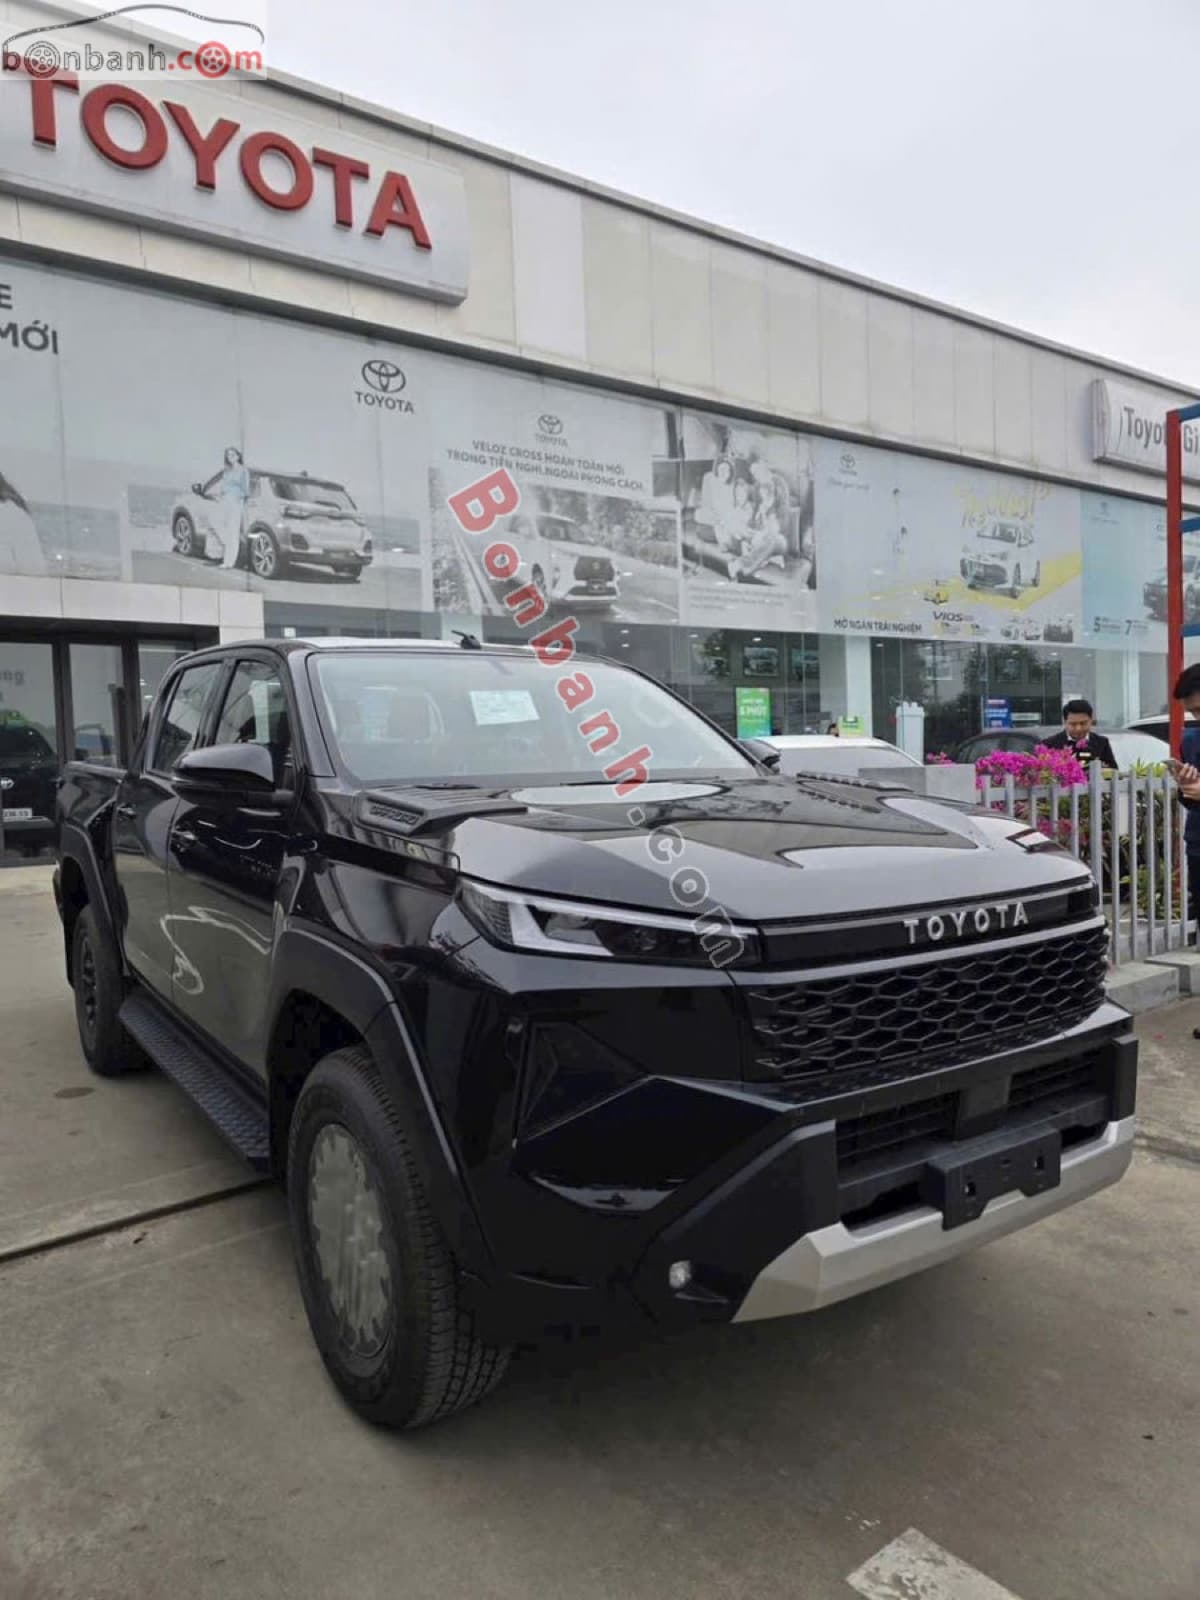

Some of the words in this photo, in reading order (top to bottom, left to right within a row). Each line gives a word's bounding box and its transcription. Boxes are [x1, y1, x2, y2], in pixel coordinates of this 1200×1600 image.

[6, 58, 432, 250] TOYOTA
[355, 391, 415, 415] TOYOTA
[1123, 405, 1167, 449] Toyo
[447, 449, 487, 465] TRONG
[472, 440, 507, 455] VELOZ
[509, 446, 542, 461] CROSS
[903, 901, 1029, 944] TOYOTA
